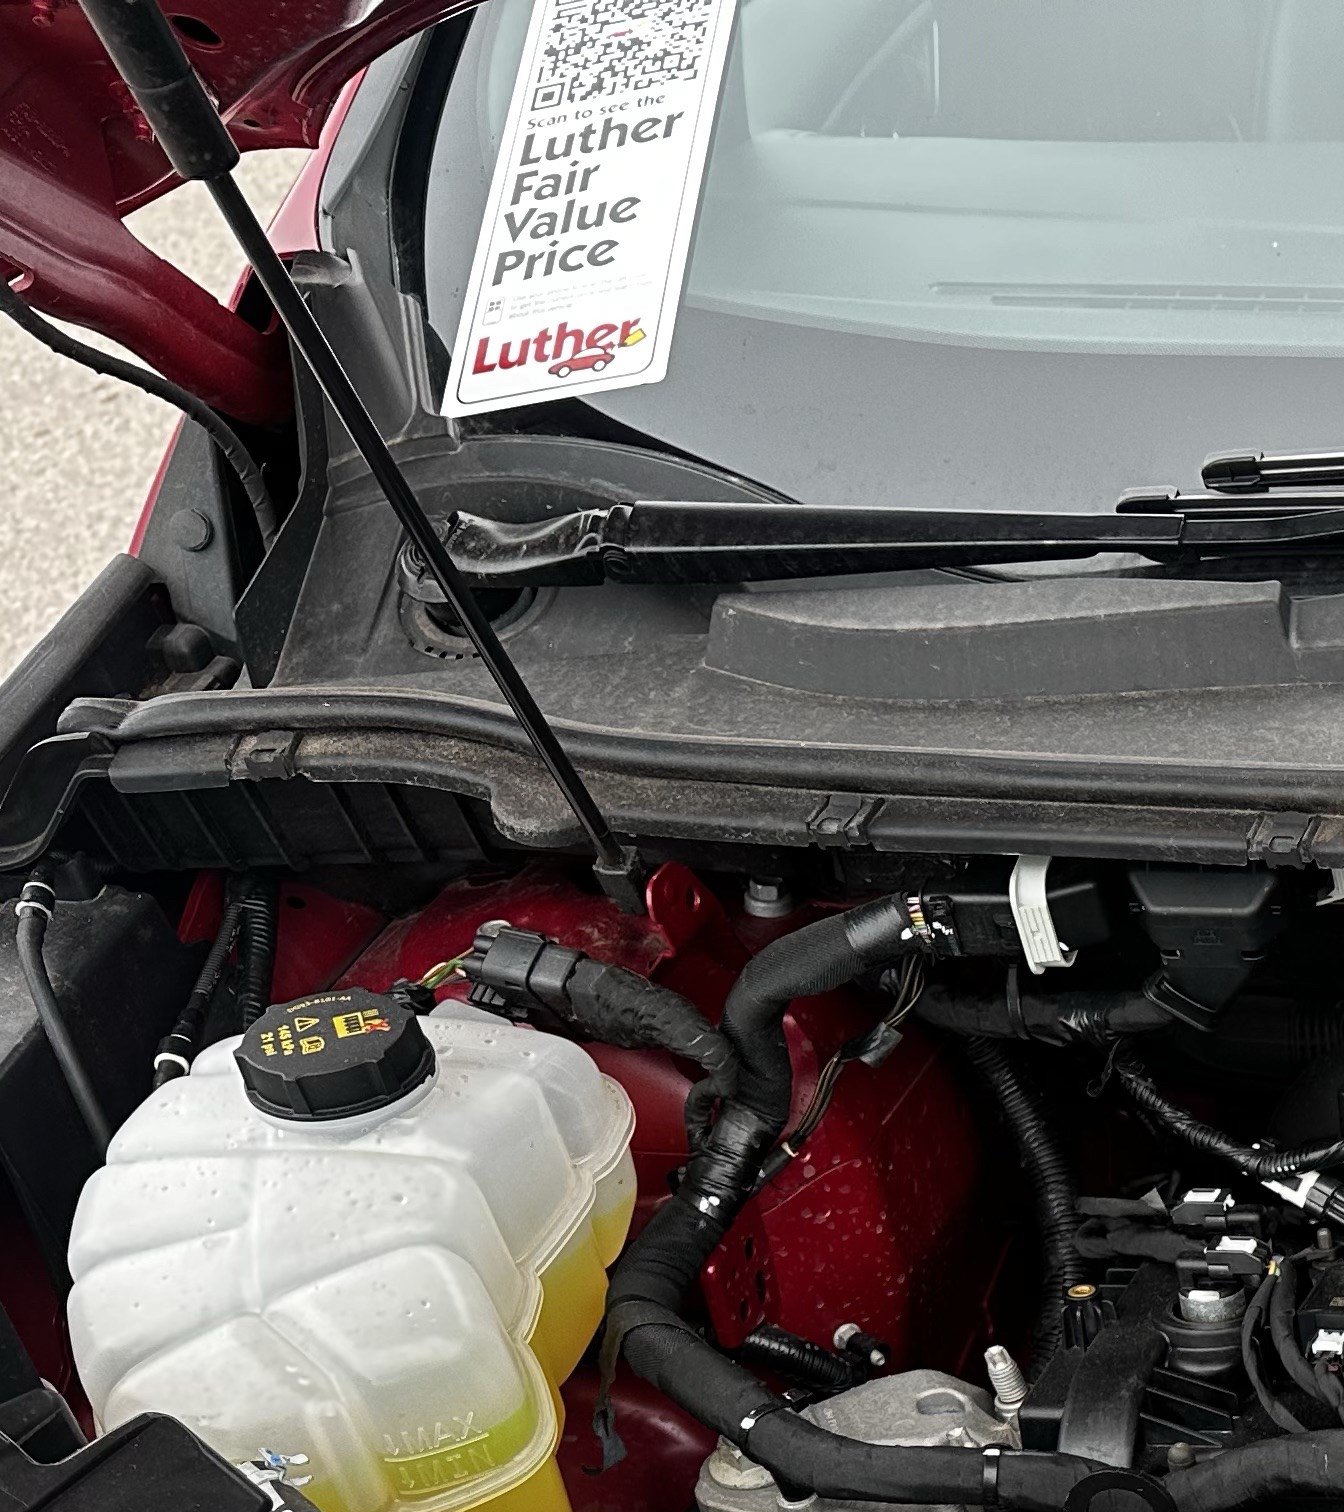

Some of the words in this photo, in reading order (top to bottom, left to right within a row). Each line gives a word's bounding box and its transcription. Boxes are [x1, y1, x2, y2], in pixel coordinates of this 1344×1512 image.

[527, 112, 567, 131] Scan
[575, 107, 593, 120] to
[599, 101, 629, 116] see
[637, 93, 665, 107] the
[518, 109, 686, 166] Luther
[510, 160, 600, 206] Fair
[503, 196, 641, 243] Value
[491, 239, 620, 287] Price
[472, 317, 642, 375] Luther
